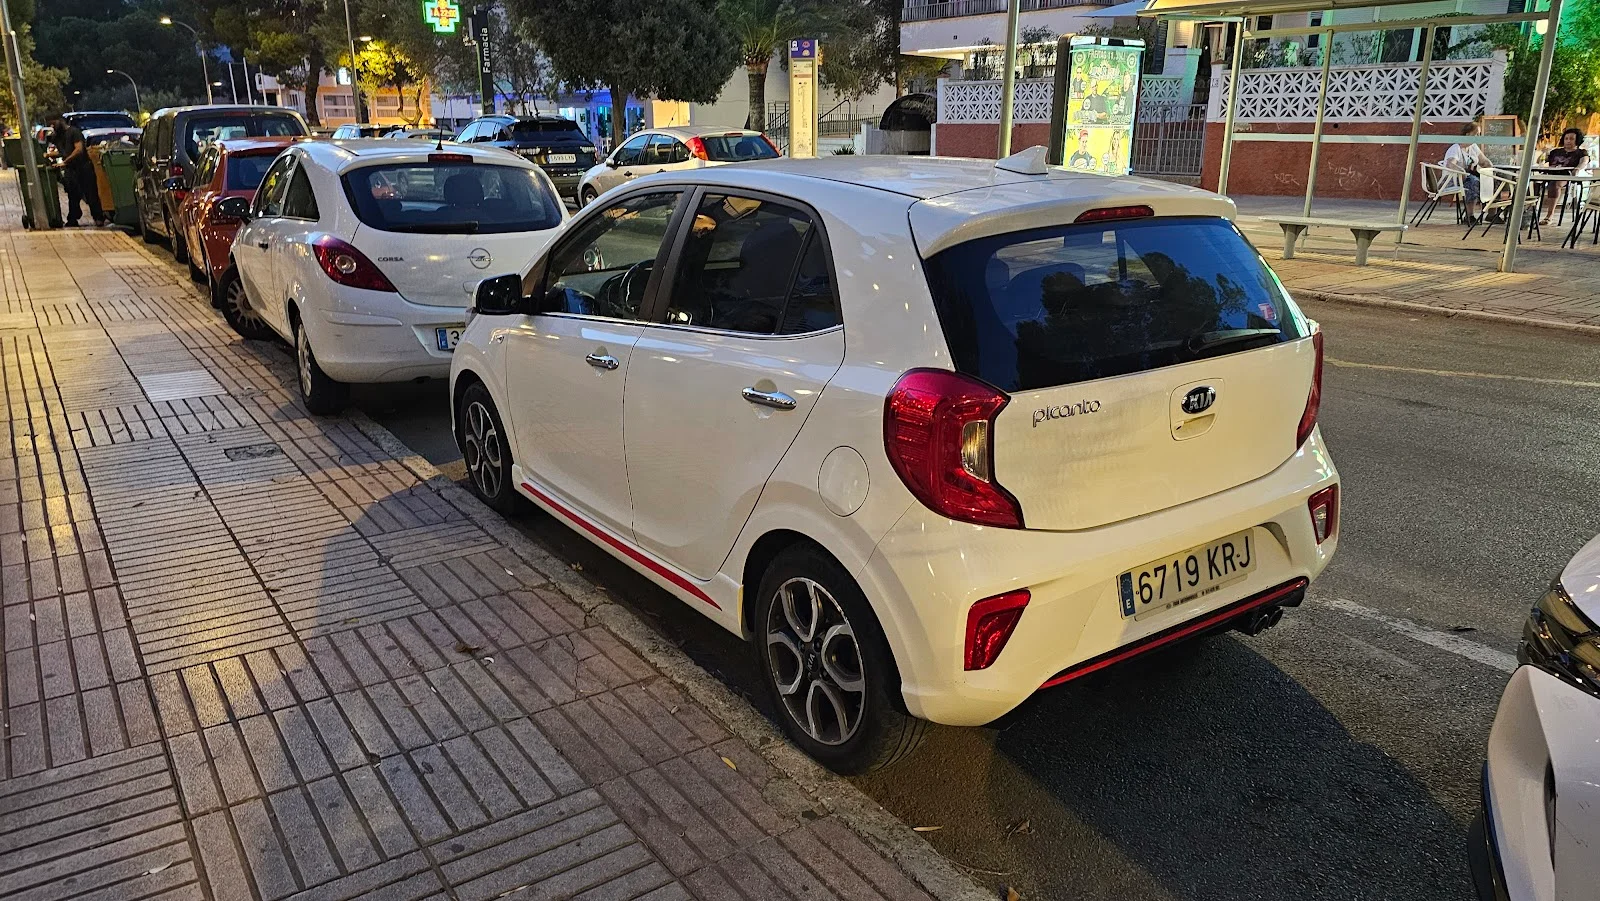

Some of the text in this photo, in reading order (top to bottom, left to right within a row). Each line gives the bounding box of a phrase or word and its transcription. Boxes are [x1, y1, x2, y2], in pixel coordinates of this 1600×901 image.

[481, 27, 491, 73] Farmacia
[450, 329, 465, 346] 3
[1189, 389, 1213, 411] KIA
[1032, 399, 1102, 428] picanto
[1138, 554, 1200, 604] 6719
[1206, 535, 1251, 581] KRJ
[1126, 598, 1132, 609] E
[806, 653, 815, 670] KIA
